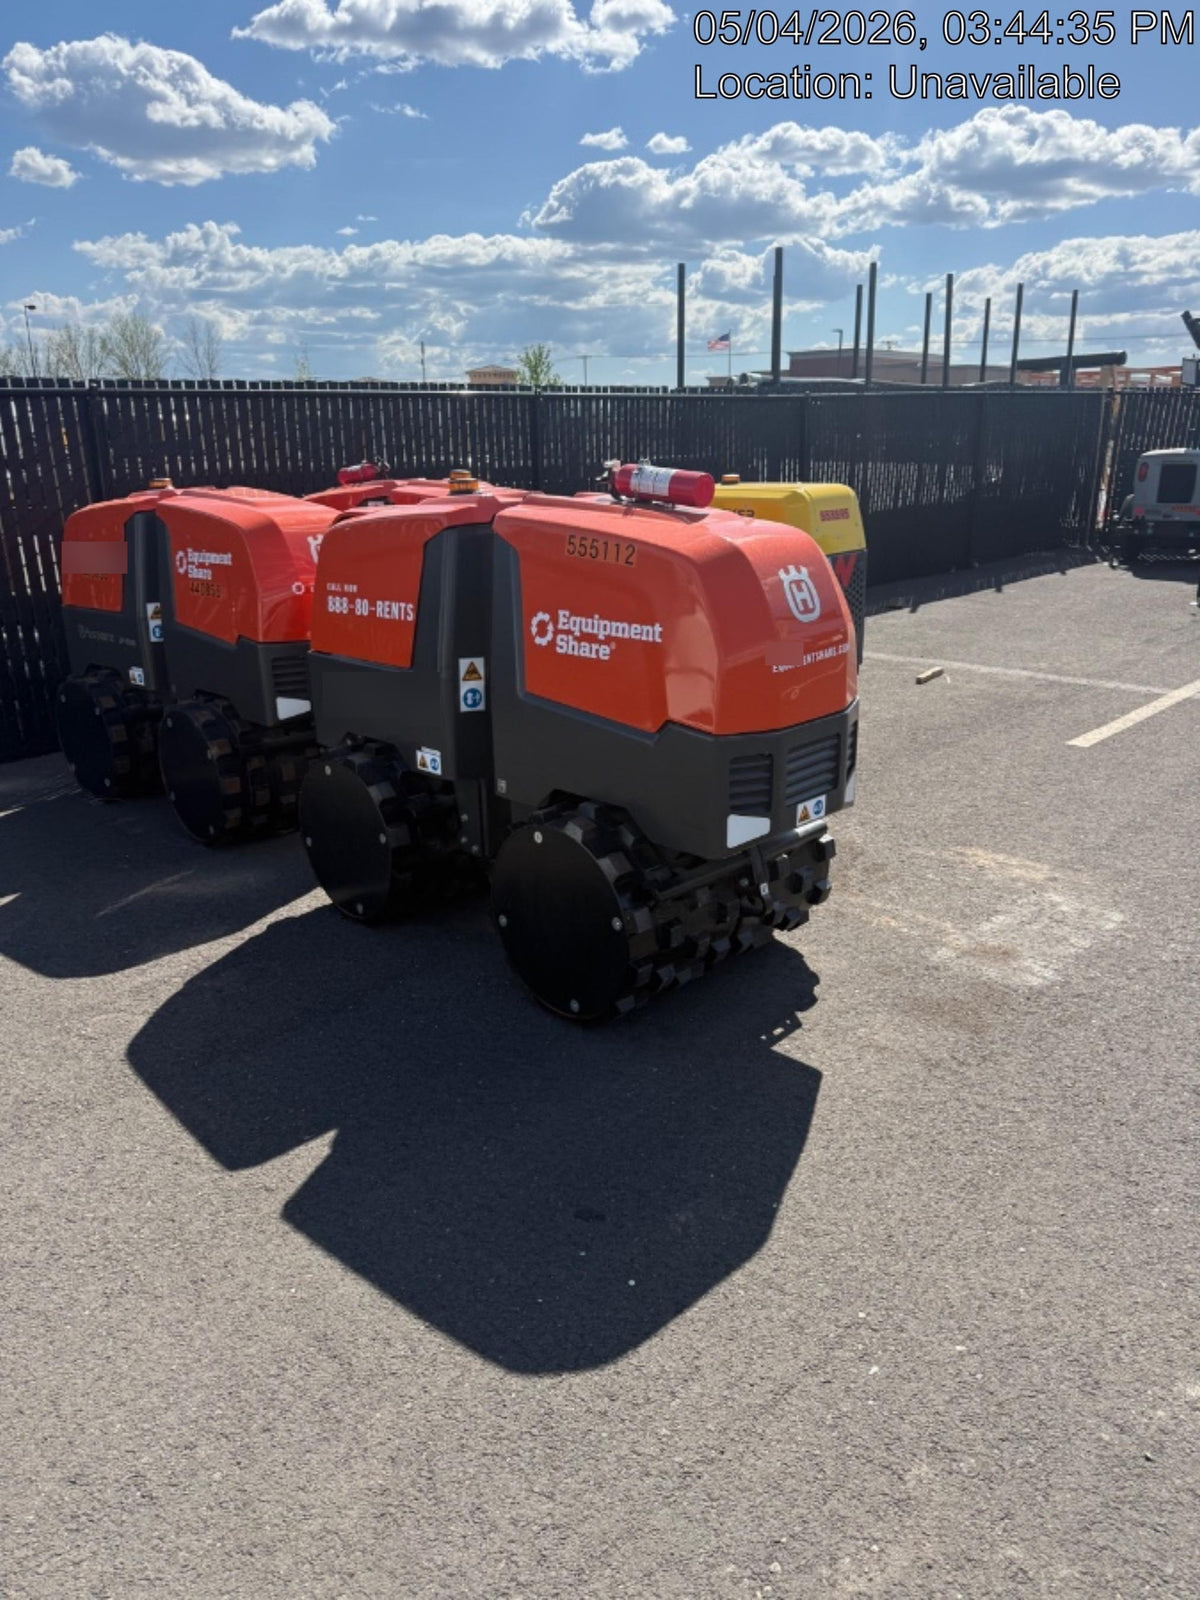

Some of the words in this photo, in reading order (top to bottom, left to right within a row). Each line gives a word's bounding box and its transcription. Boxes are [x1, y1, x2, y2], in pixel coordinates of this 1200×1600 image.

[565, 534, 637, 567] 555112
[327, 595, 414, 622] 888-80-RENTS
[557, 609, 663, 644] Equipment
